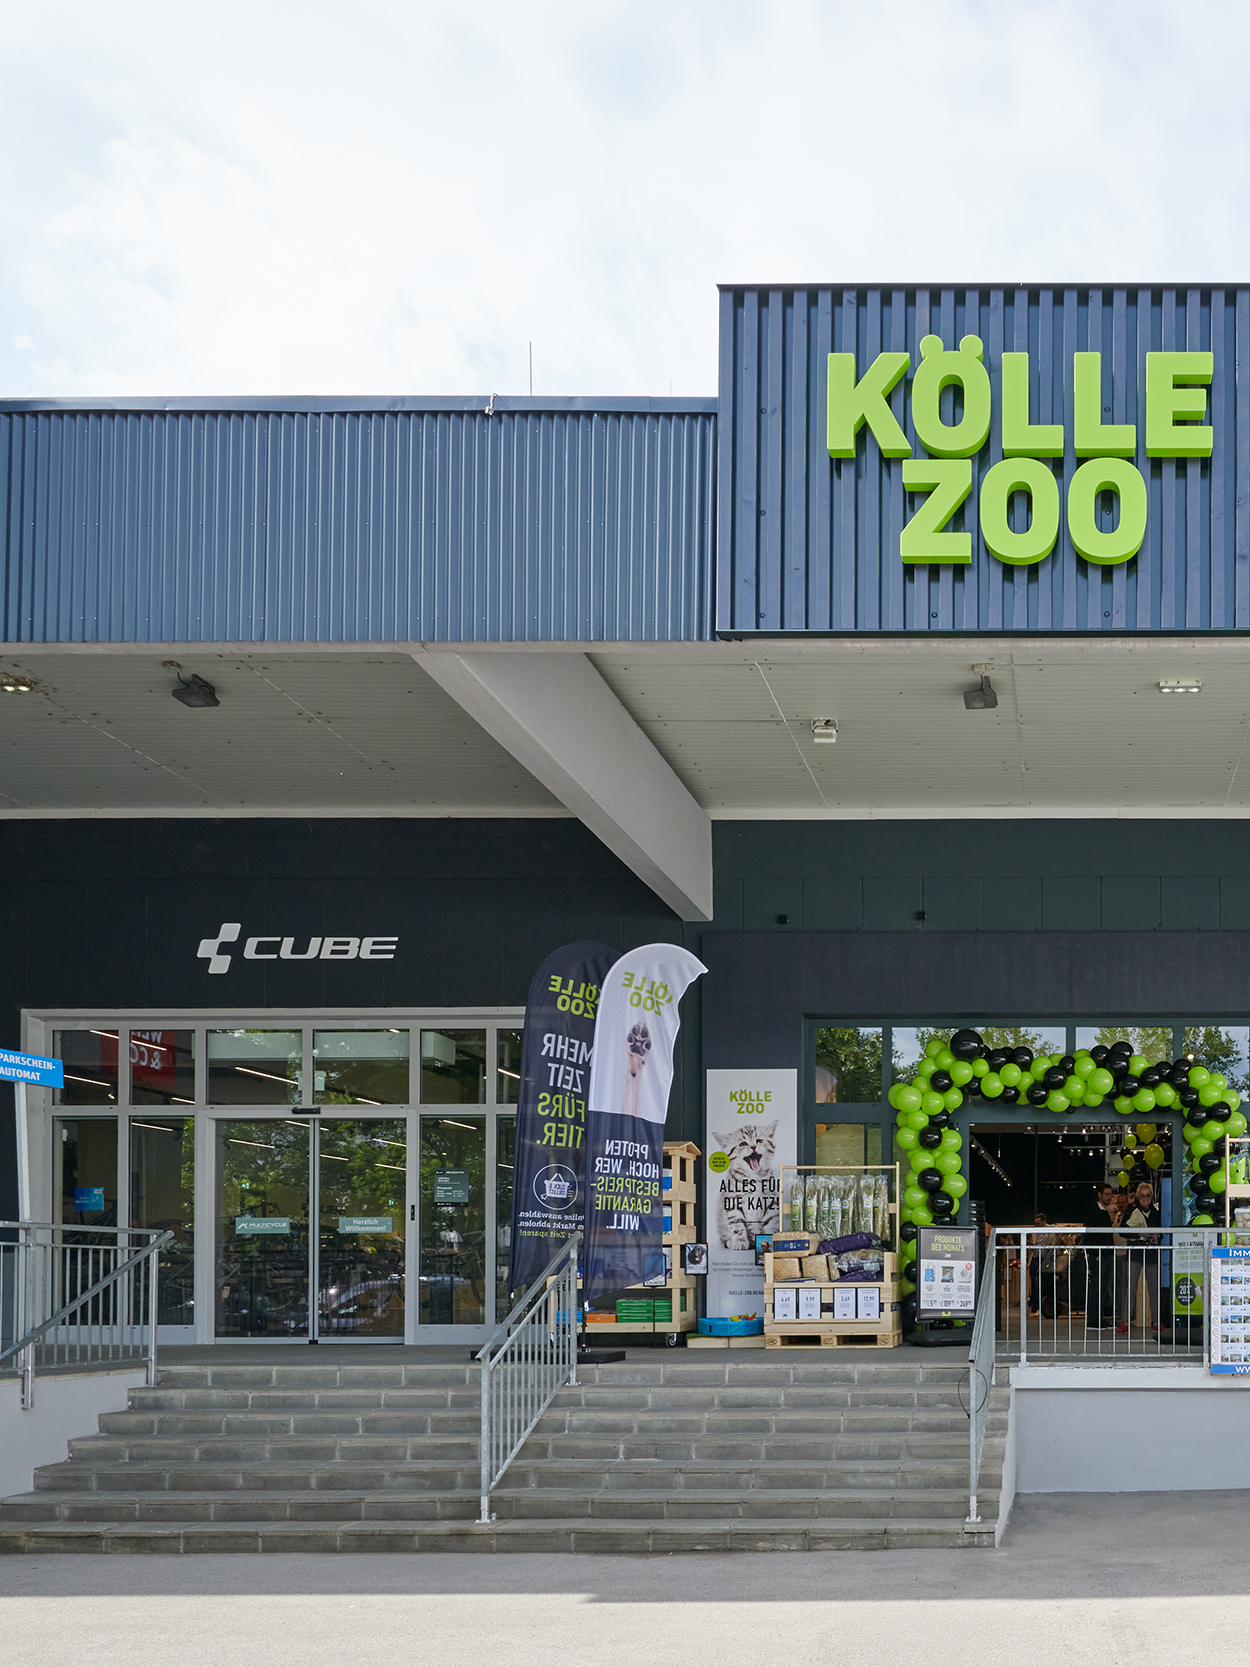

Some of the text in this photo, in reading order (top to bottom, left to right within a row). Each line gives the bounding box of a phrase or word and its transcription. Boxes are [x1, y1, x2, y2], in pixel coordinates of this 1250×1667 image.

[827, 334, 1214, 458] KÖLLE
[900, 457, 1147, 565] ZOO
[243, 936, 399, 960] CUBE
[0, 1052, 56, 1071] PARKSCHEIN-
[0, 1067, 41, 1081] AUTOMAT
[729, 1089, 772, 1102] KÖLLE
[737, 1102, 764, 1114] ZOO
[719, 1179, 756, 1193] ALLES
[724, 1196, 779, 1210] DIE KATZ!
[345, 1224, 387, 1232] Willkommen!
[934, 1235, 962, 1244] PRODUKTE
[931, 1243, 965, 1252] DES MONATS
